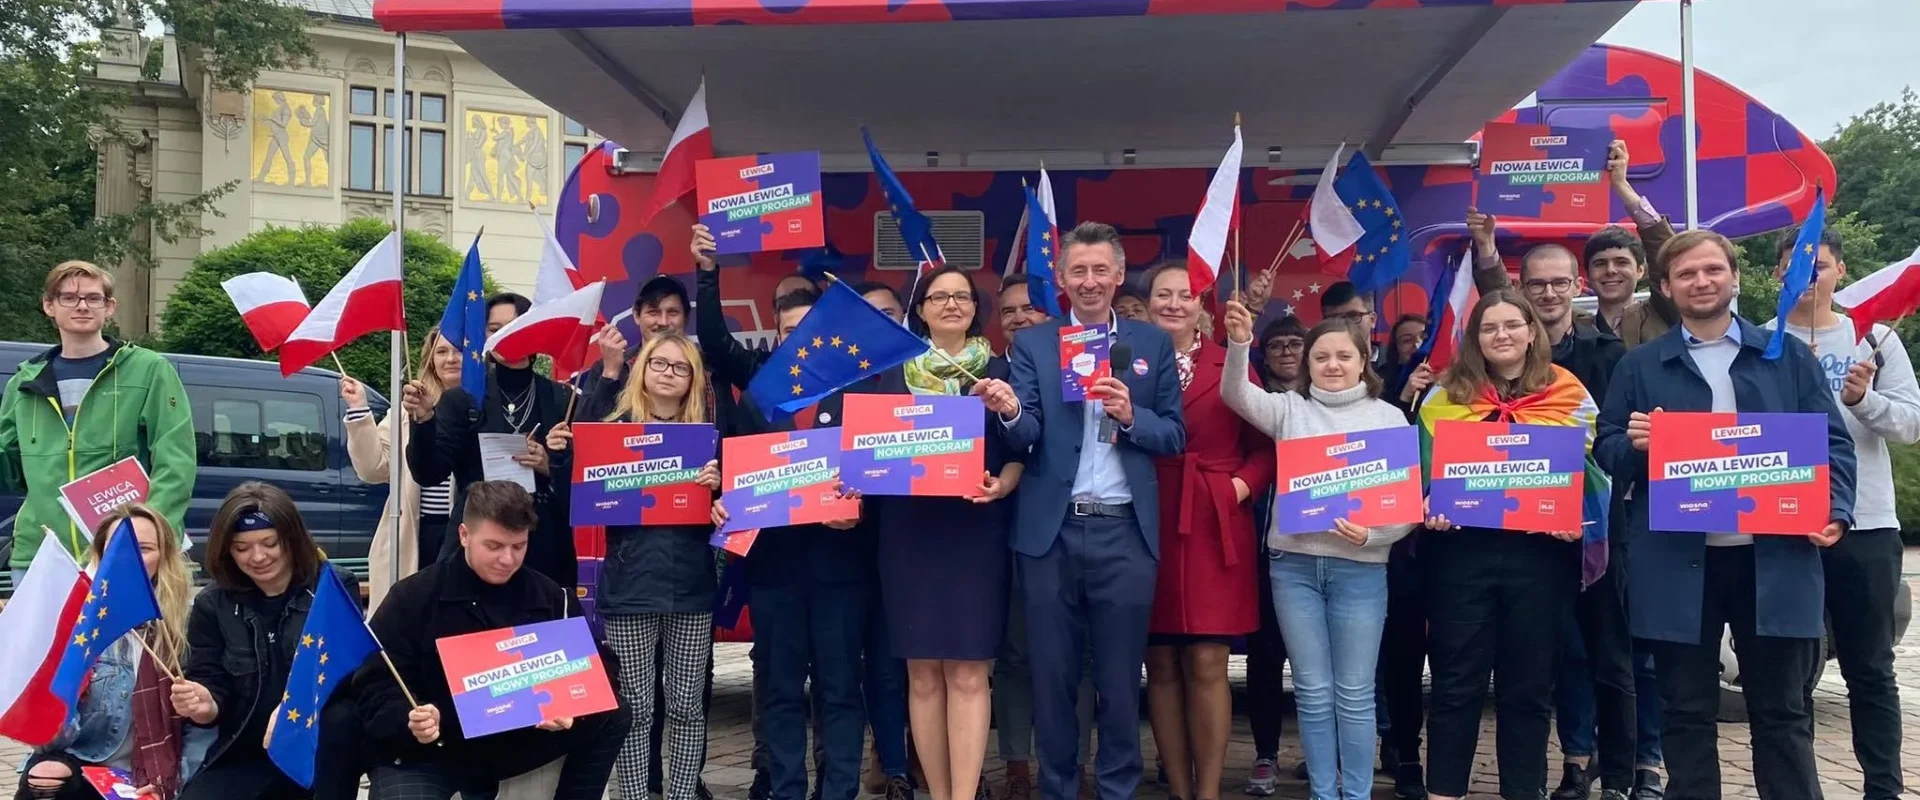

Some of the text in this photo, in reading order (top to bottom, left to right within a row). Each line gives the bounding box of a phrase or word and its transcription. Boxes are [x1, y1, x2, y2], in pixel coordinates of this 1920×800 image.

[1532, 137, 1565, 145] LEWICA
[742, 165, 772, 177] LEWICA
[1494, 160, 1580, 173] NOWA LEWICA
[1511, 172, 1599, 184] NOWY PROGRAM
[711, 187, 790, 210] NOWA LEWICA
[729, 195, 810, 219] NOWY PROGRAM
[895, 406, 931, 416] LEWICA
[625, 435, 661, 446] LEWICA
[857, 430, 949, 447] NOWA LEWICA
[1489, 436, 1527, 444] LEWICA
[1714, 426, 1759, 438] LEWICA
[772, 440, 806, 453] LEWICA
[876, 440, 971, 458] NOWY PROGRAM
[1328, 442, 1363, 454] LEWICA
[587, 459, 678, 479] NOWA LEWICA
[737, 460, 824, 486] NOWA LEWICA
[1448, 462, 1545, 476] NOWA LEWICA
[1669, 455, 1783, 476] NOWA LEWICA
[607, 470, 700, 490] NOWY PROGRAM
[1293, 462, 1383, 489] NOWA LEWICA
[1312, 470, 1407, 497] NOWY PROGRAM
[1468, 475, 1569, 488] NOWY PROGRAM
[1694, 468, 1812, 489] NOWY PROGRAM
[87, 480, 135, 506] LEWICA
[756, 480, 789, 494] NOWY
[93, 489, 141, 515] razem
[498, 634, 536, 650] LEWICA
[467, 653, 564, 688] NOWA LEWICA
[493, 659, 590, 695] NOWY PROGRAM
